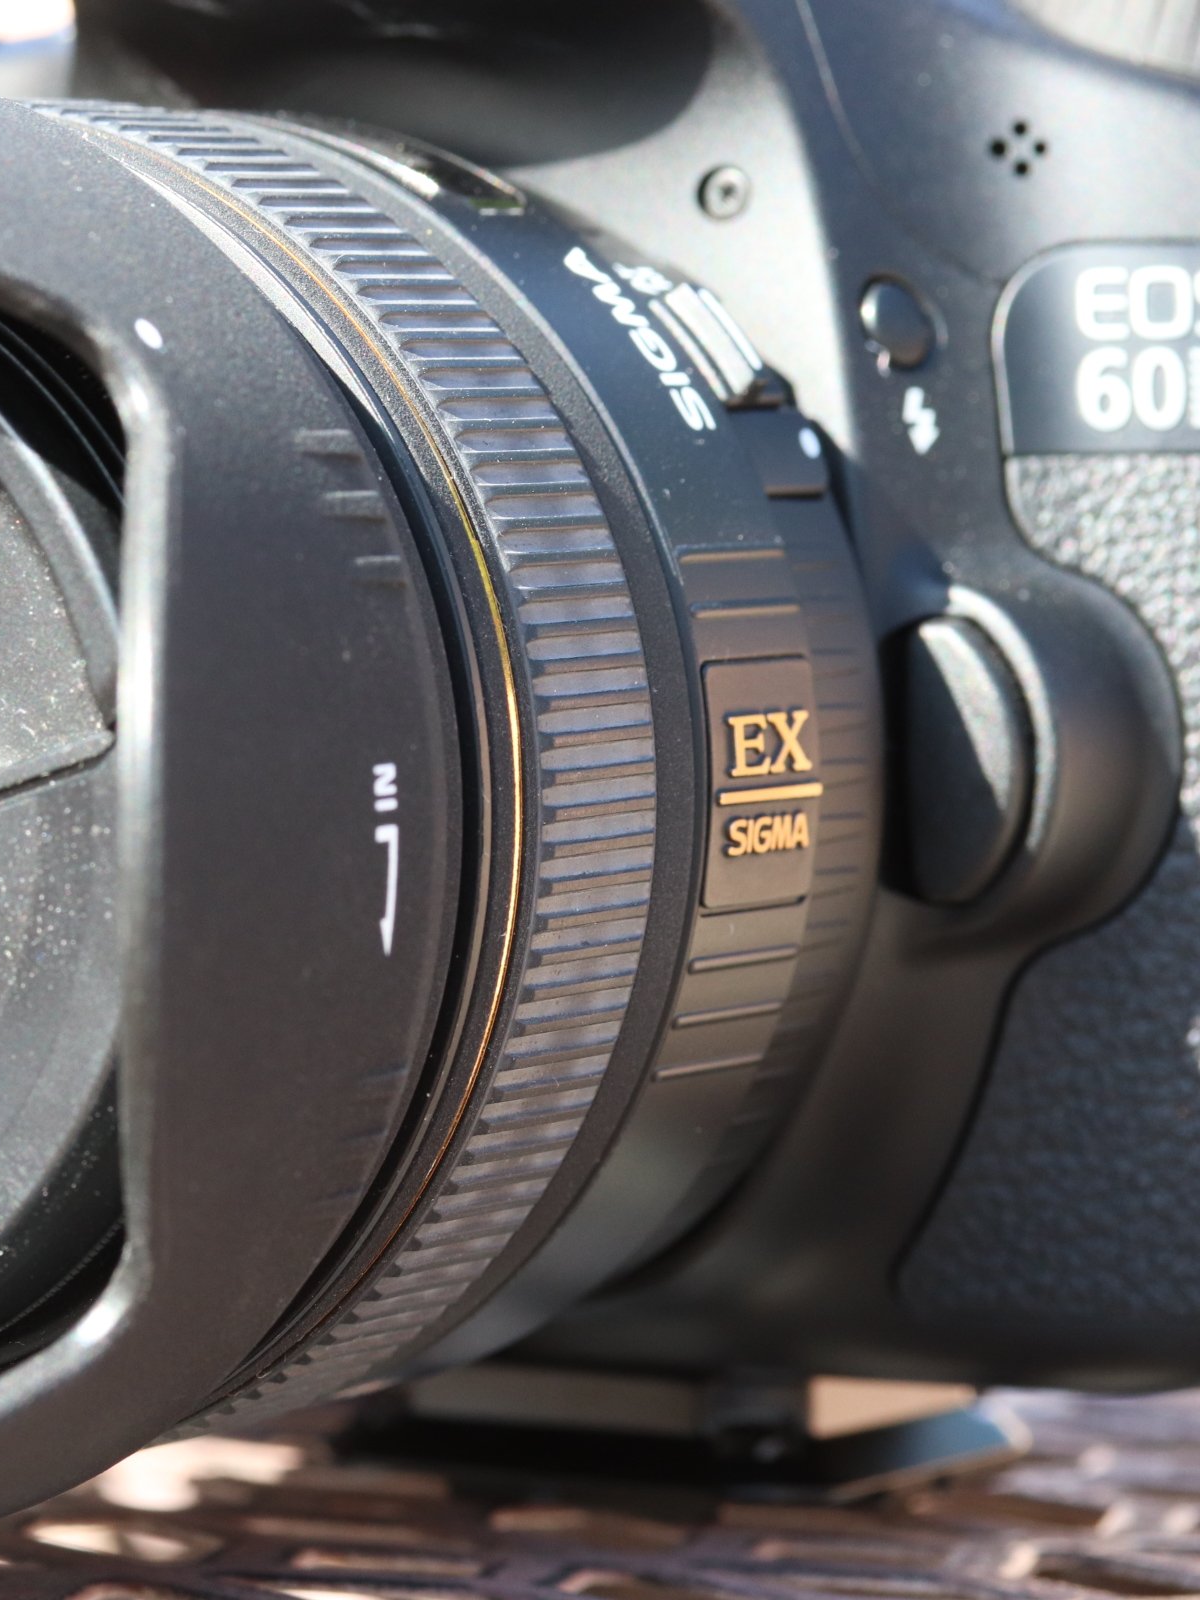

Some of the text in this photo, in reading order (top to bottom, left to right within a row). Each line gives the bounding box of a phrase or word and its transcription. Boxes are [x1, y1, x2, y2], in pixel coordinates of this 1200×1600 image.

[563, 247, 716, 430] SIGMA
[1075, 265, 1200, 341] EO
[1075, 345, 1200, 432] 60
[726, 709, 813, 777] EX
[372, 762, 399, 812] IN
[726, 812, 810, 857] SIGMA
